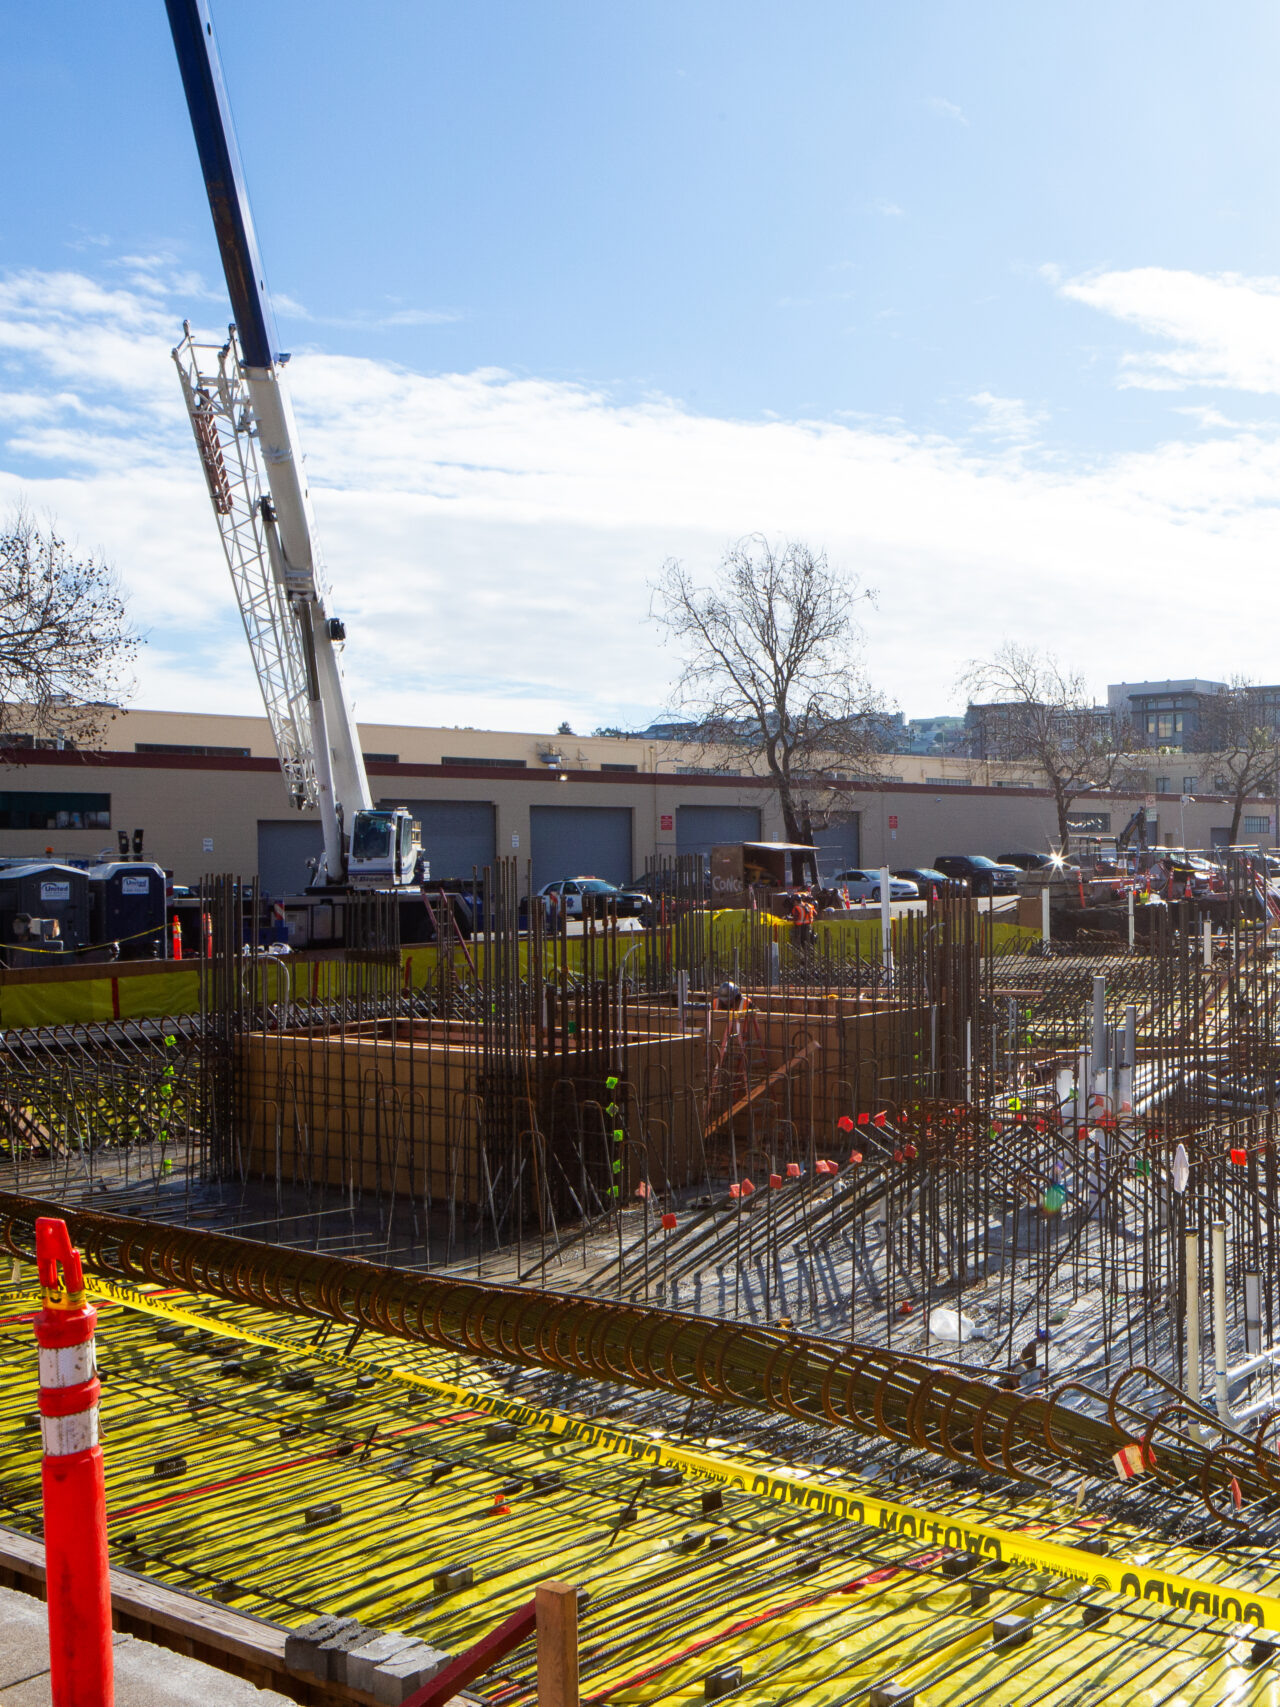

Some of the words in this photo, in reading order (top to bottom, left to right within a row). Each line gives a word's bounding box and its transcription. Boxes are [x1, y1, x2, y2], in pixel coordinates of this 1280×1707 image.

[751, 1474, 865, 1524] CUIDADO
[879, 1508, 1002, 1561] CAUTION
[1120, 1572, 1265, 1628] CUIDADO
